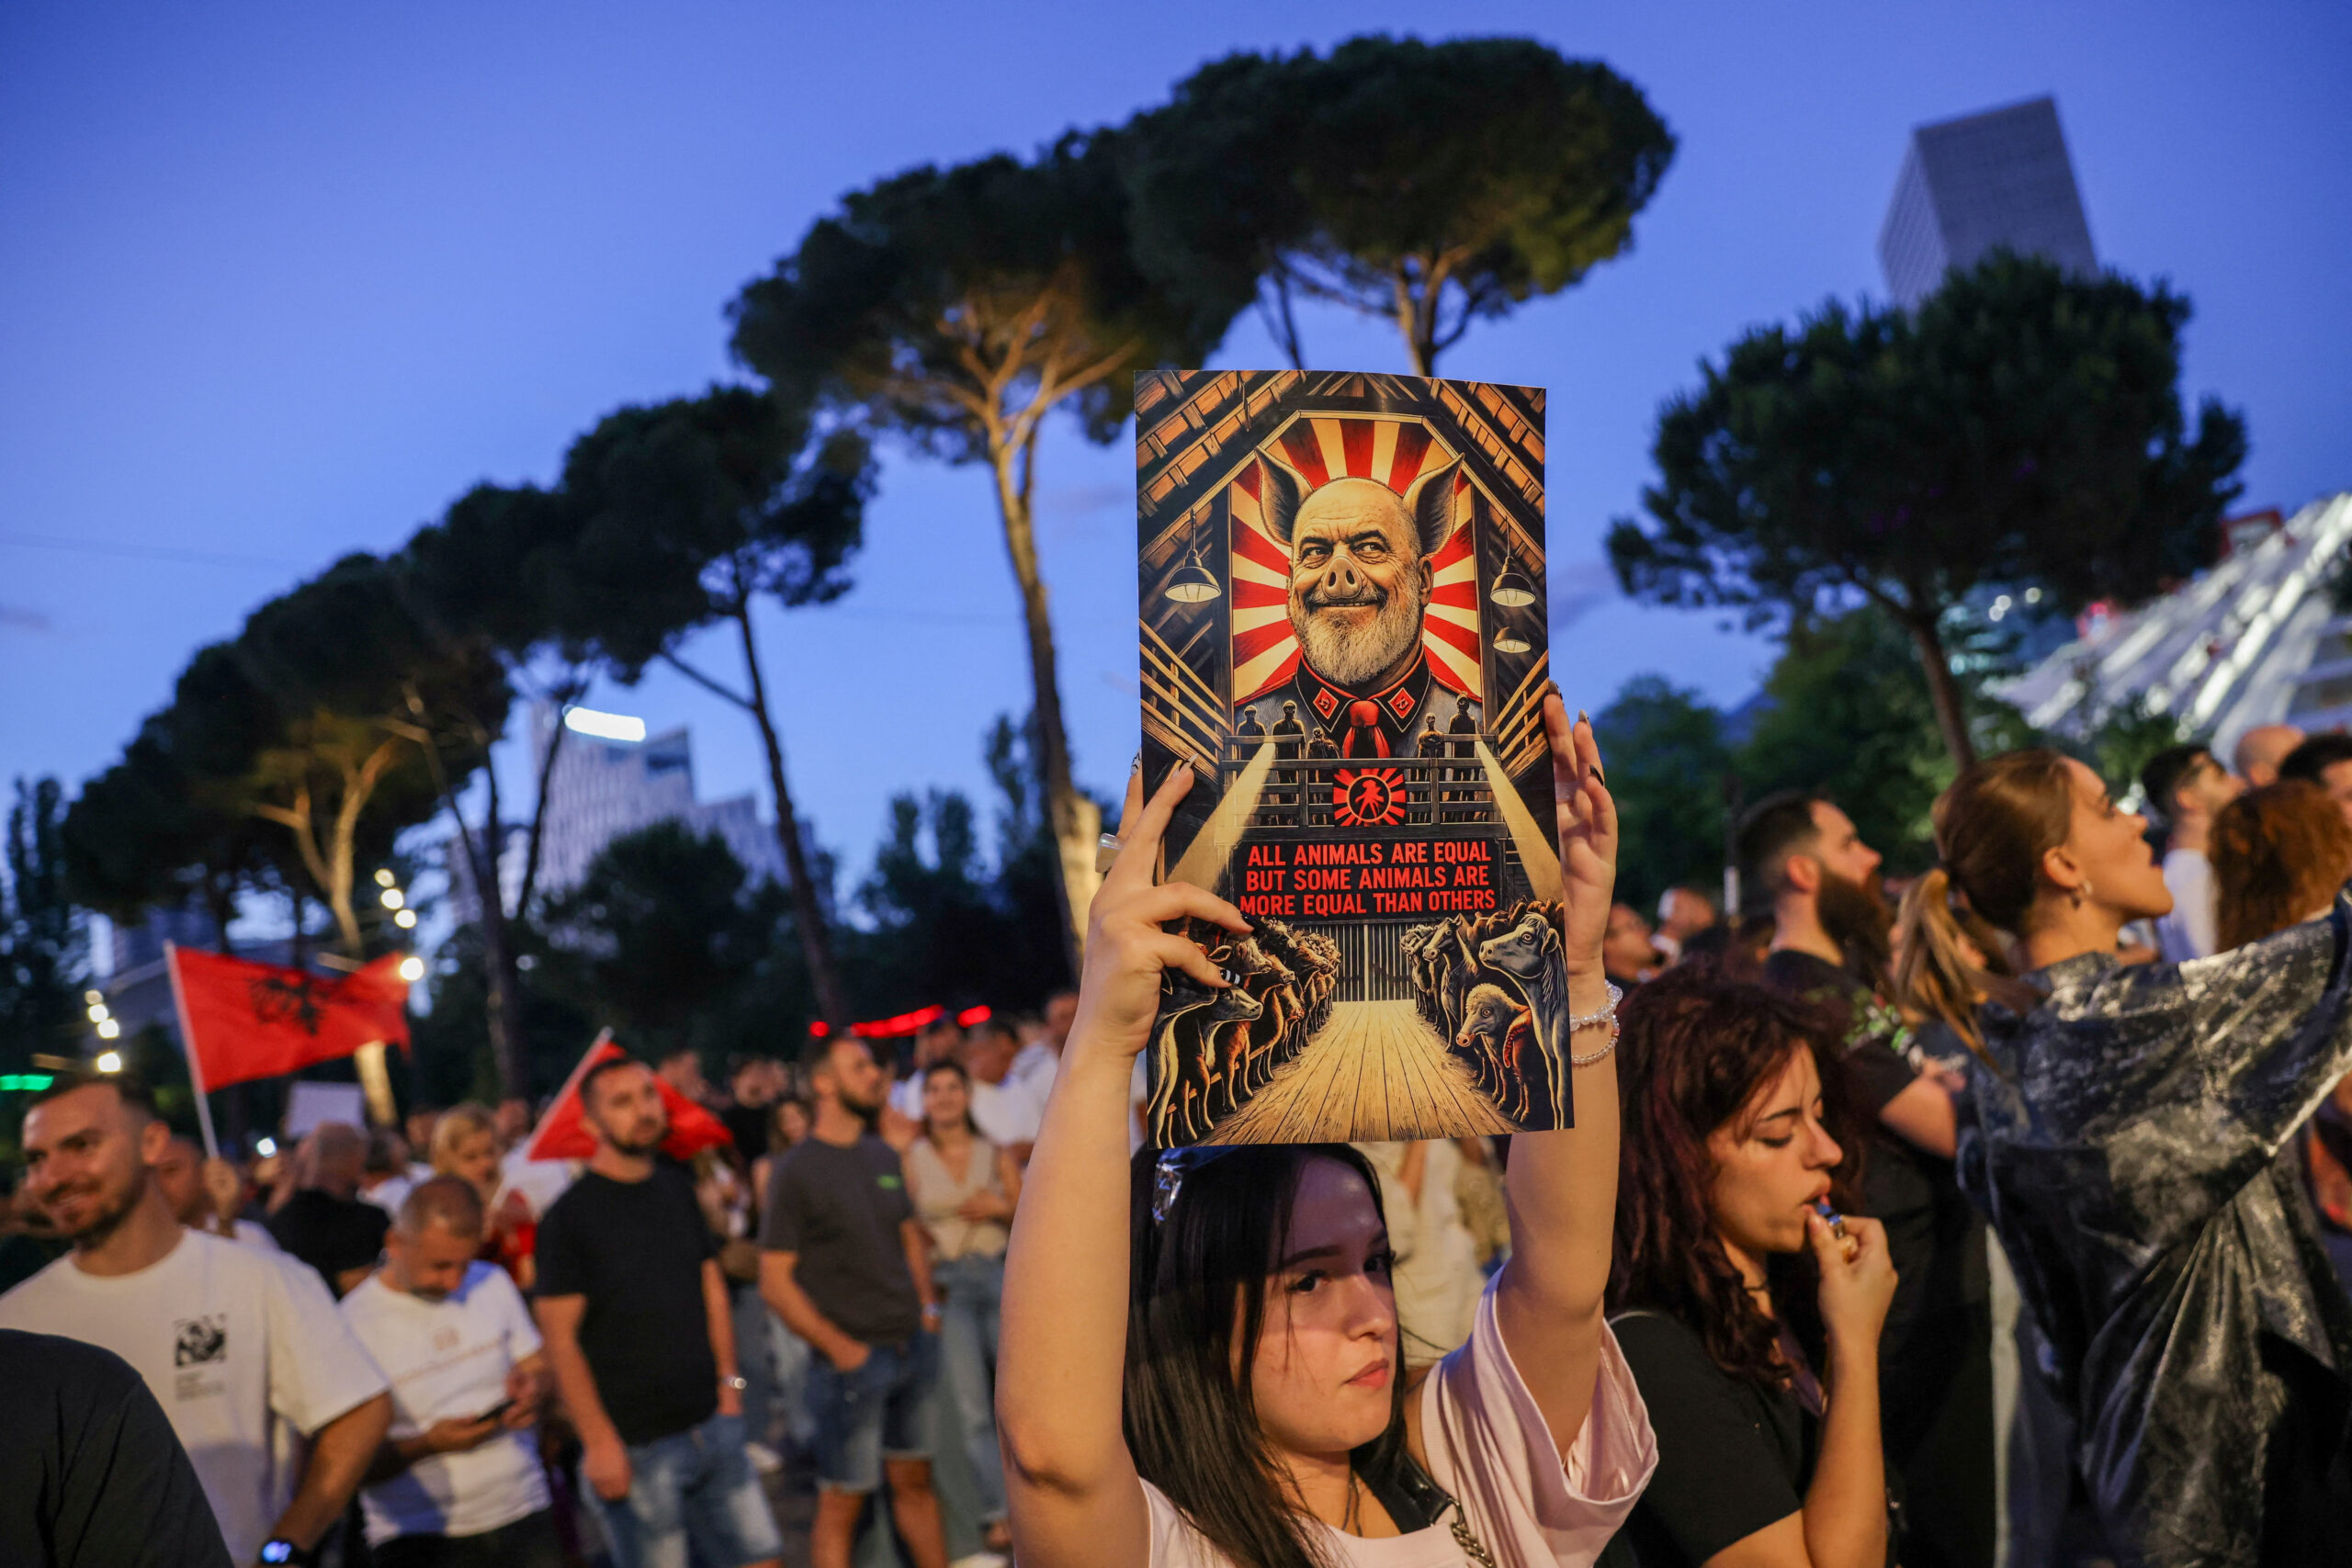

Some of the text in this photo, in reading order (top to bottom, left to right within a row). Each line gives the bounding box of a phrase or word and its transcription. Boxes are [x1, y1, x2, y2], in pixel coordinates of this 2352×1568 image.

[1247, 840, 1492, 866] ALL ANIMALS ARE EQUAL
[1246, 864, 1489, 892] BUT SOME ANIMALS ARE
[1240, 888, 1496, 917] MORE EQUAL THAN OTHERS
